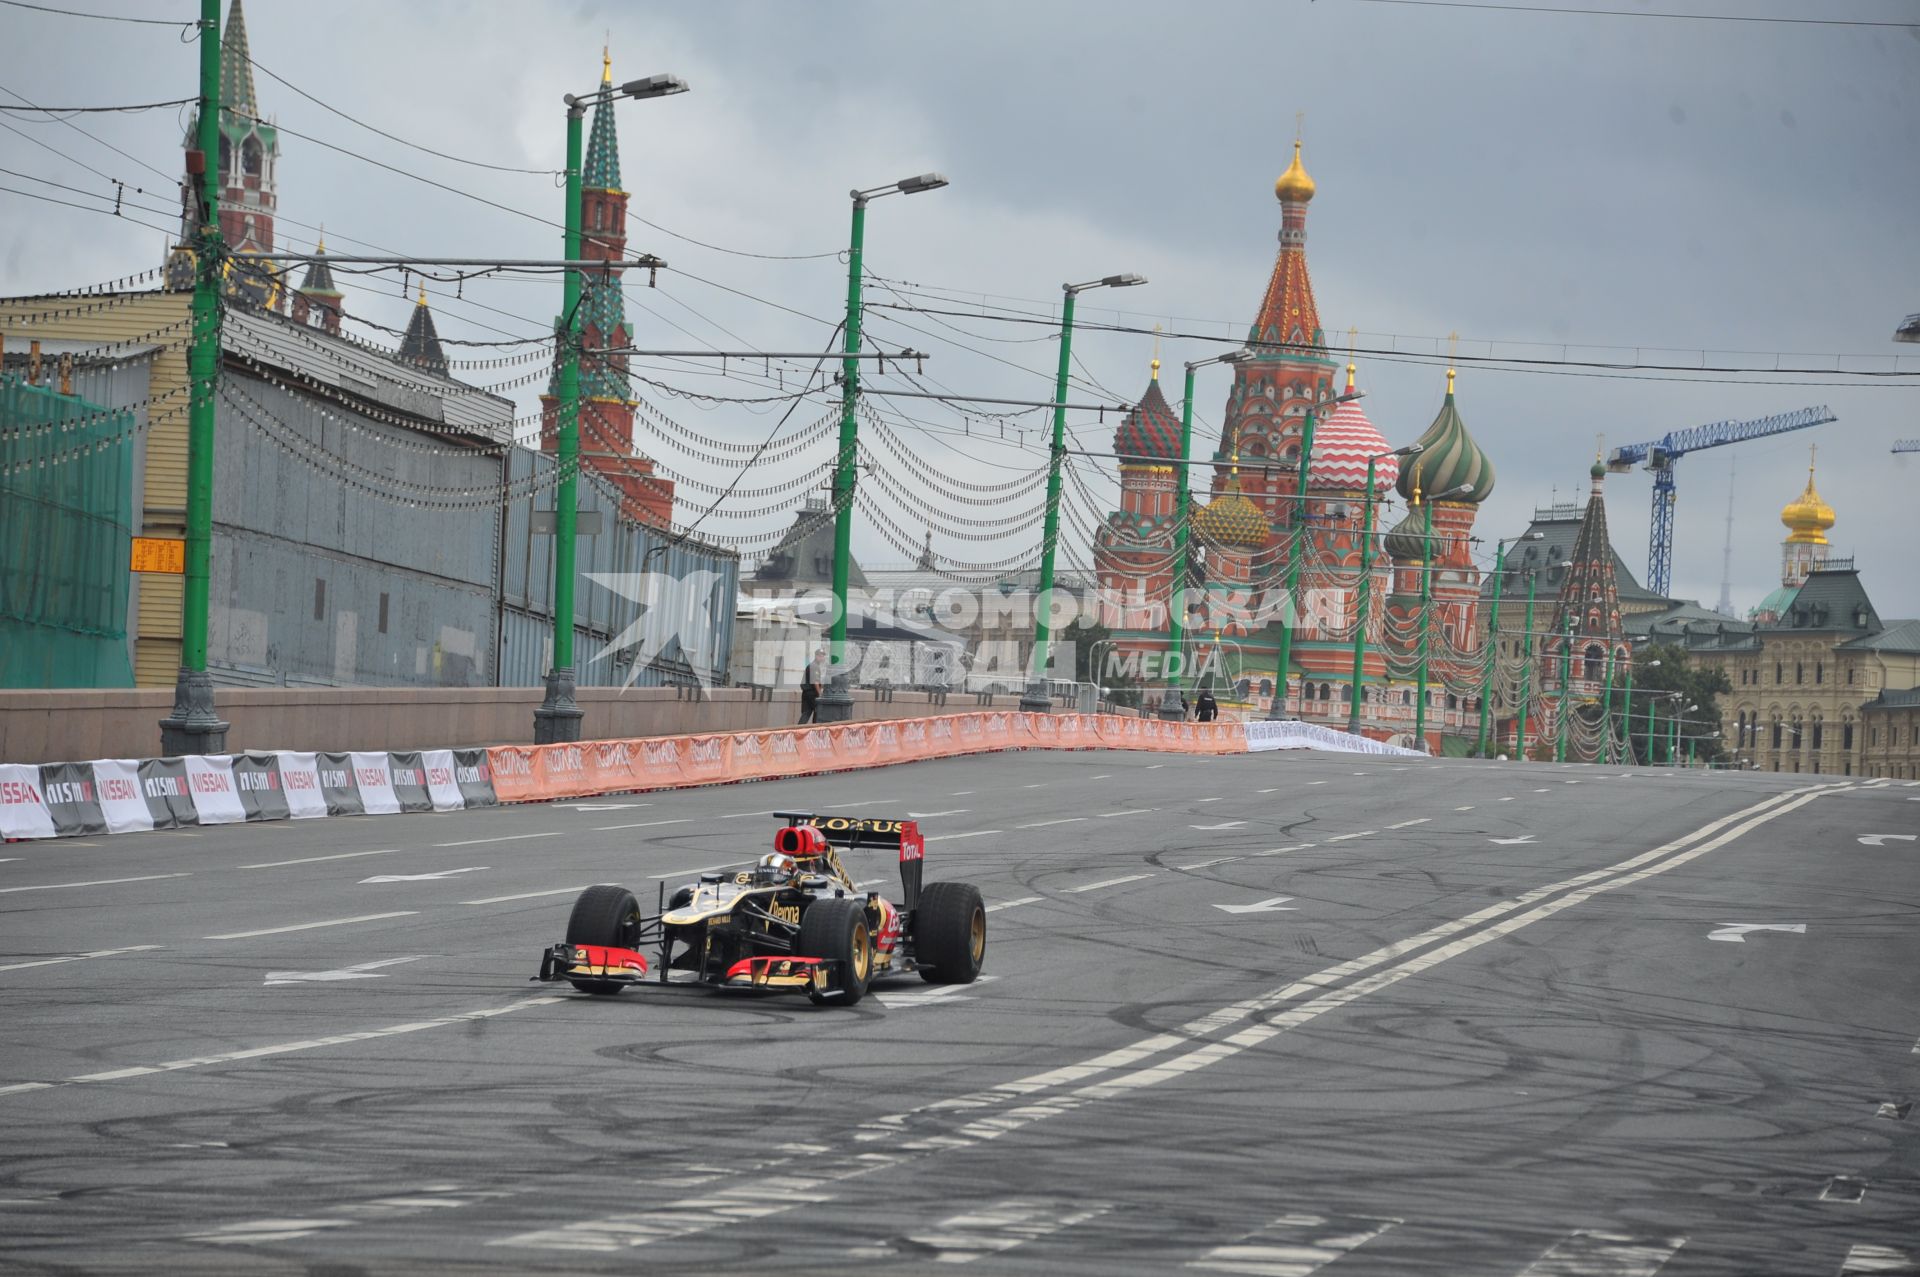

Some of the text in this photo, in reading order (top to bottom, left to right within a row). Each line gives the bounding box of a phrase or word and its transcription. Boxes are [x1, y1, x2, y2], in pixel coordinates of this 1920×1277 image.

[191, 772, 230, 793] NISSAN
[283, 770, 316, 790] NISSAN
[356, 767, 387, 787] NISSAN
[0, 782, 40, 805] ISSAN
[100, 779, 137, 801] NISSAN
[810, 816, 902, 833] LOTUS
[902, 841, 921, 860] TOTAL
